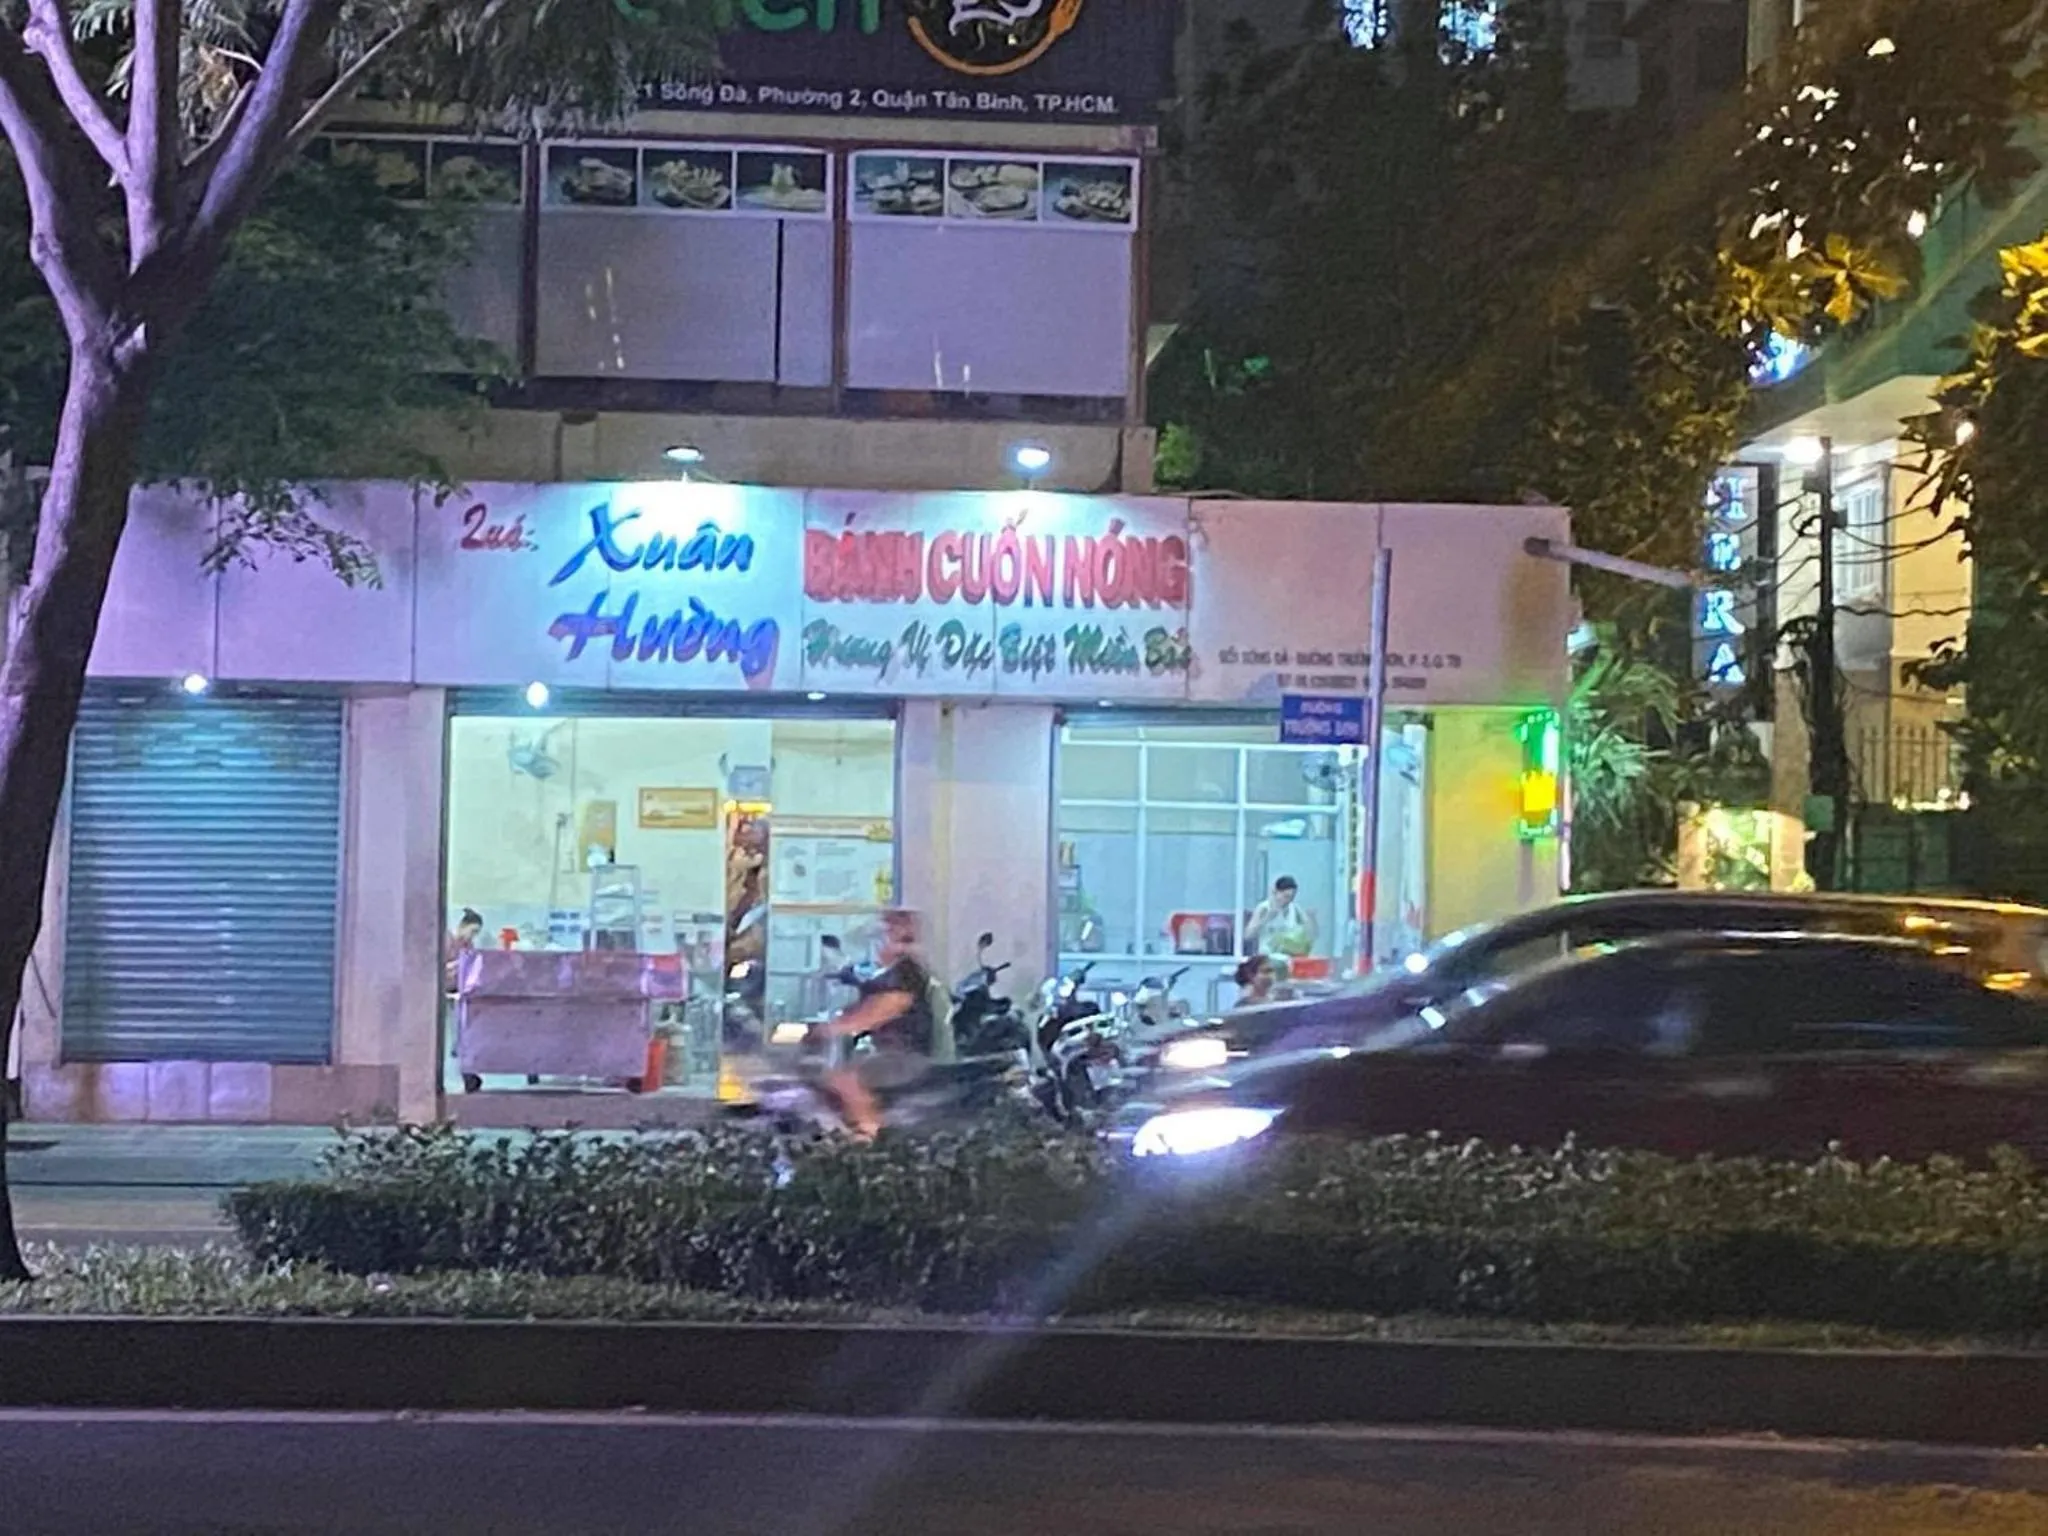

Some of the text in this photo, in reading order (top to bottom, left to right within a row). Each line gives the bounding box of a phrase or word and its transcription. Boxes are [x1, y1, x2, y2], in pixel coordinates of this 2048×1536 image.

[871, 89, 927, 111] Quận
[933, 90, 970, 109] Tân
[547, 502, 755, 588] Xuân
[804, 508, 1192, 610] BÁNH CUỐN NÓNG
